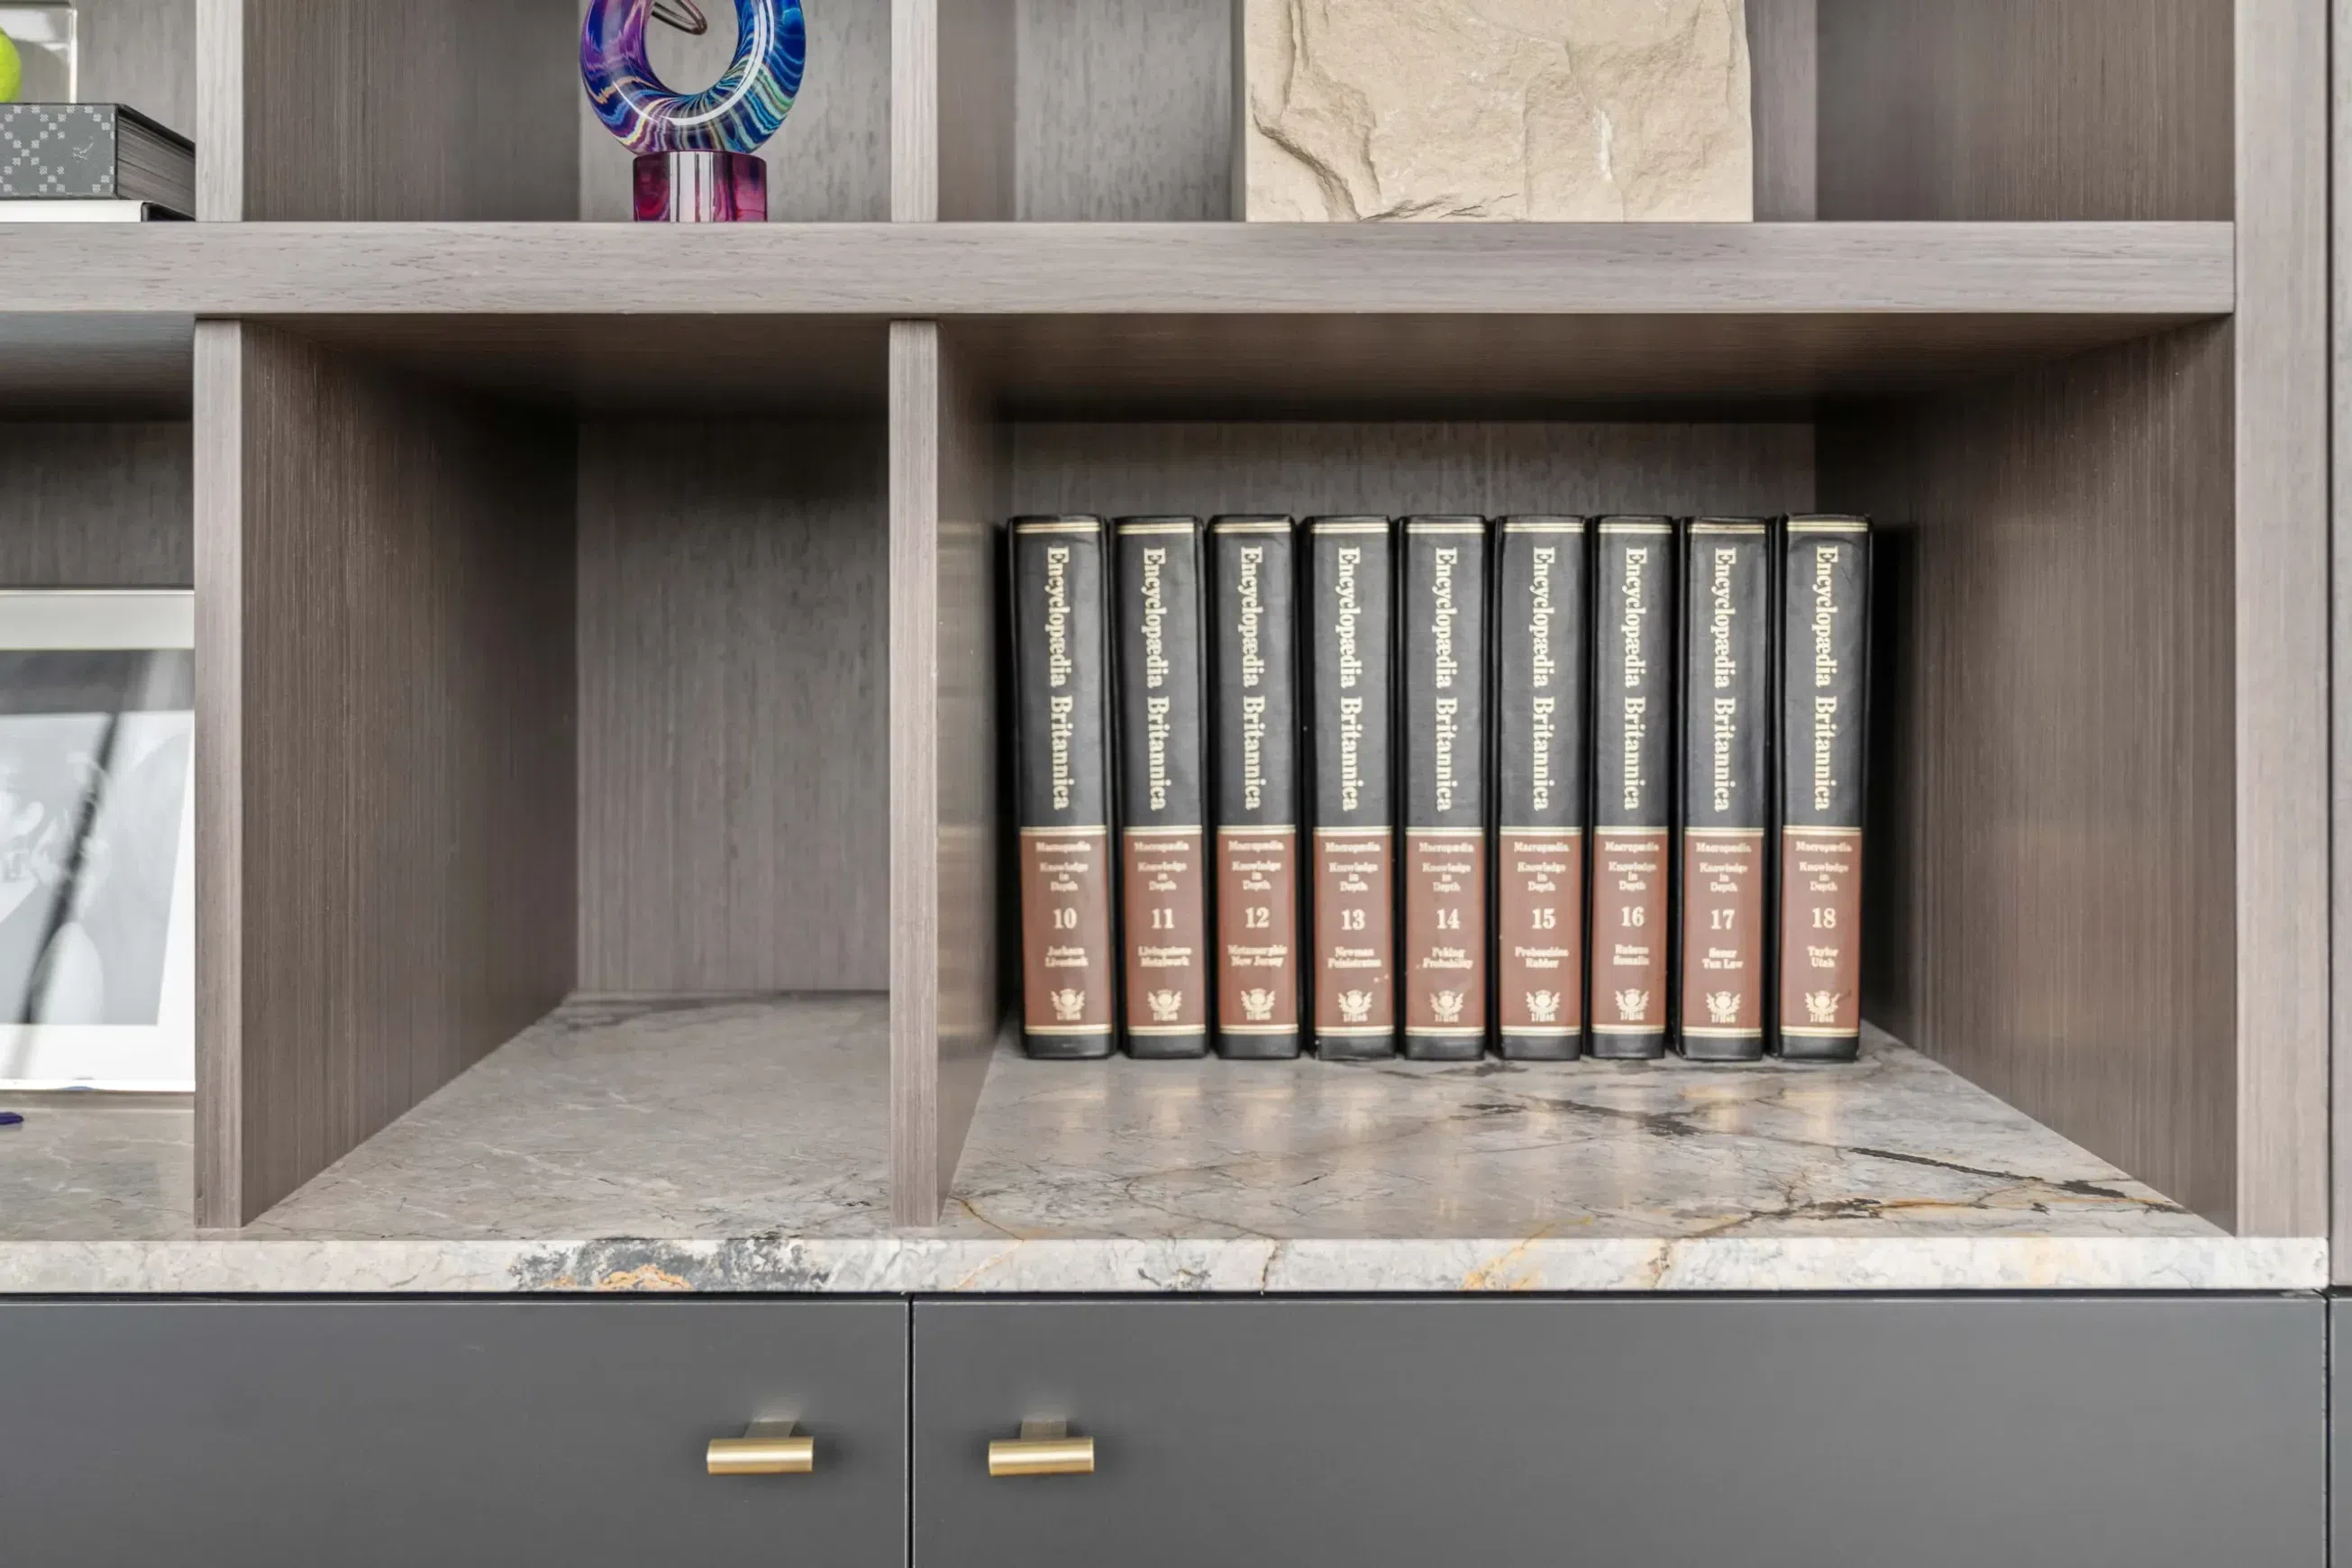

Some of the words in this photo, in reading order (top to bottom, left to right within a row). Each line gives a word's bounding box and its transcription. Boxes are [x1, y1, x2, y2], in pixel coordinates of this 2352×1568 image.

[1051, 696, 1075, 811] Britannica
[1148, 696, 1171, 812] Britannica
[1244, 696, 1267, 811] Britannica
[1341, 697, 1364, 812] Britannica
[1436, 697, 1458, 812] Britannica
[1533, 697, 1556, 811] Britannica
[1623, 697, 1647, 811] Britannica
[1714, 697, 1737, 812] Britannica
[1814, 696, 1837, 811] Britannica
[1053, 908, 1077, 929] 10
[1152, 908, 1174, 929] 11
[1245, 907, 1270, 928] 12
[1341, 909, 1365, 930] 13
[1436, 908, 1460, 929] 14
[1532, 908, 1555, 929] 15
[1621, 907, 1644, 927] 16
[1711, 909, 1735, 930] 17
[1812, 907, 1836, 928] 18
